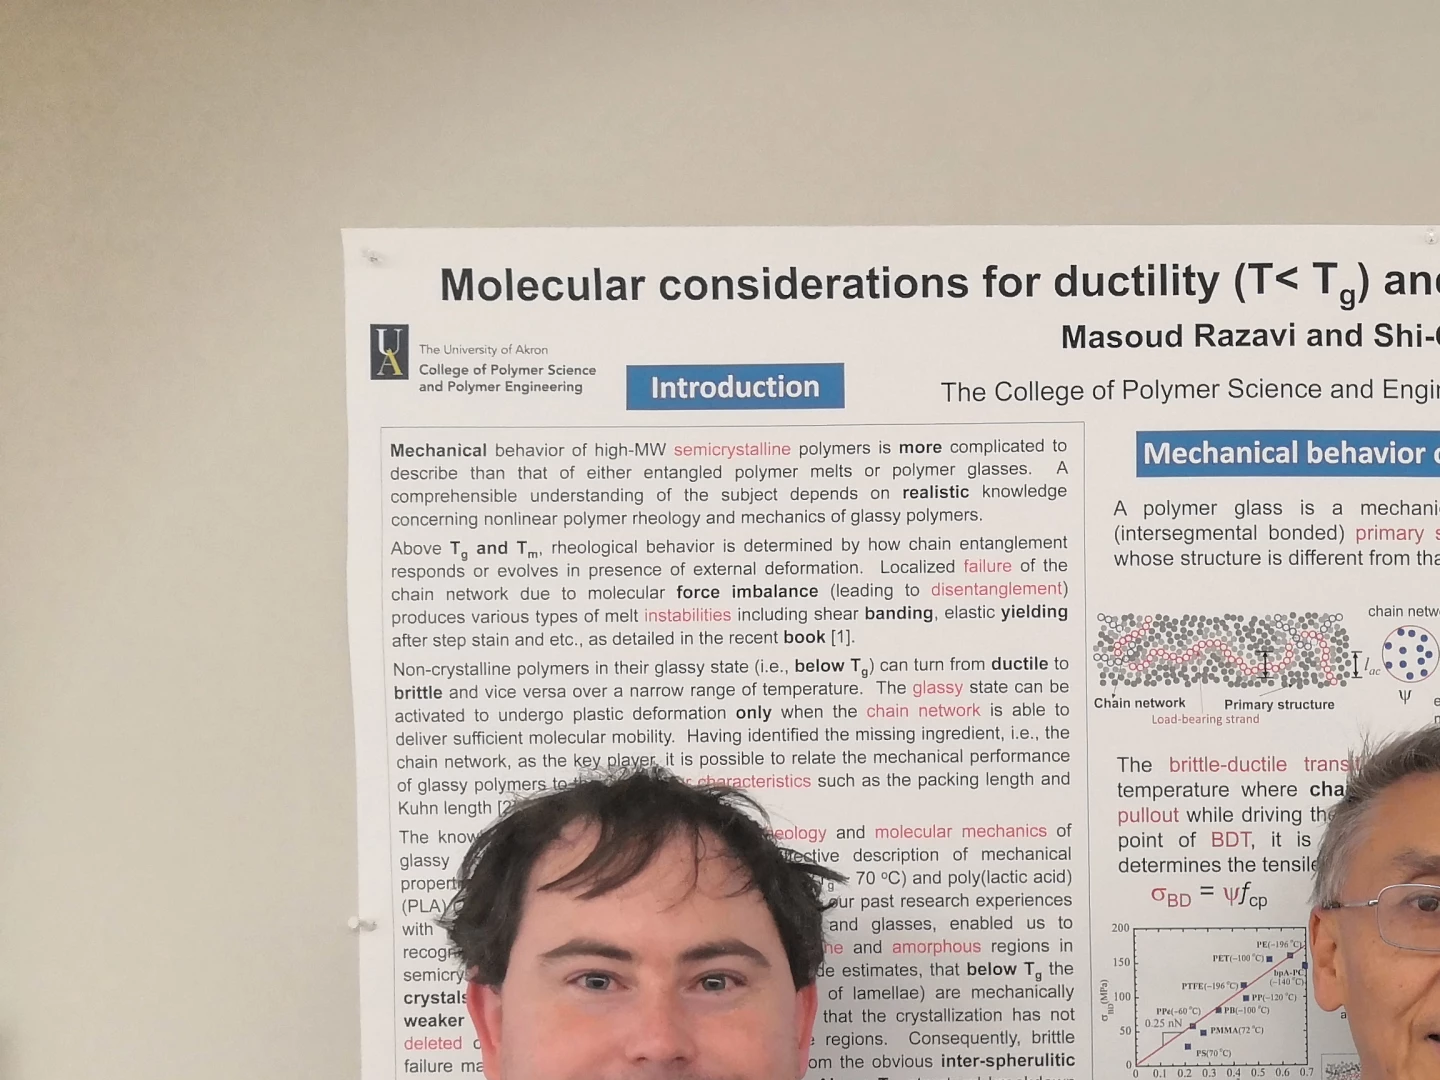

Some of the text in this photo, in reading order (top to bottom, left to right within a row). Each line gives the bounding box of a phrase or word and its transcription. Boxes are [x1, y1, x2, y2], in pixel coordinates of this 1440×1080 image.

[440, 266, 646, 301] Molecular
[658, 265, 968, 301] considerations
[981, 264, 1041, 298] for
[1053, 262, 1220, 304] ductility
[1061, 322, 1182, 349] Masoud
[1194, 321, 1295, 347] Razavi
[1306, 322, 1362, 347] and
[418, 342, 548, 357] The University of Akron
[418, 362, 597, 379] College of Polymer Science
[418, 379, 583, 395] and Polymer Engineering
[651, 373, 819, 399] Introduction
[940, 381, 986, 402] The
[994, 380, 1084, 406] College
[1091, 378, 1115, 400] of
[1122, 378, 1220, 405] Polymer
[1227, 377, 1322, 399] Science
[1329, 377, 1373, 399] and
[389, 437, 1067, 460] Mechanical behavior of high-MW semicrystalline polymers is more complicated to
[1143, 439, 1298, 464] Mechanical
[1306, 439, 1426, 464] behavior
[1113, 523, 1257, 545] (intersegmental
[1268, 523, 1344, 545] bonded)
[1355, 523, 1424, 545] primary
[1367, 604, 1403, 617] chain
[1093, 696, 1185, 709] Chain network
[1223, 698, 1335, 713] Primary structure
[1151, 712, 1259, 726] Load-bearing strand
